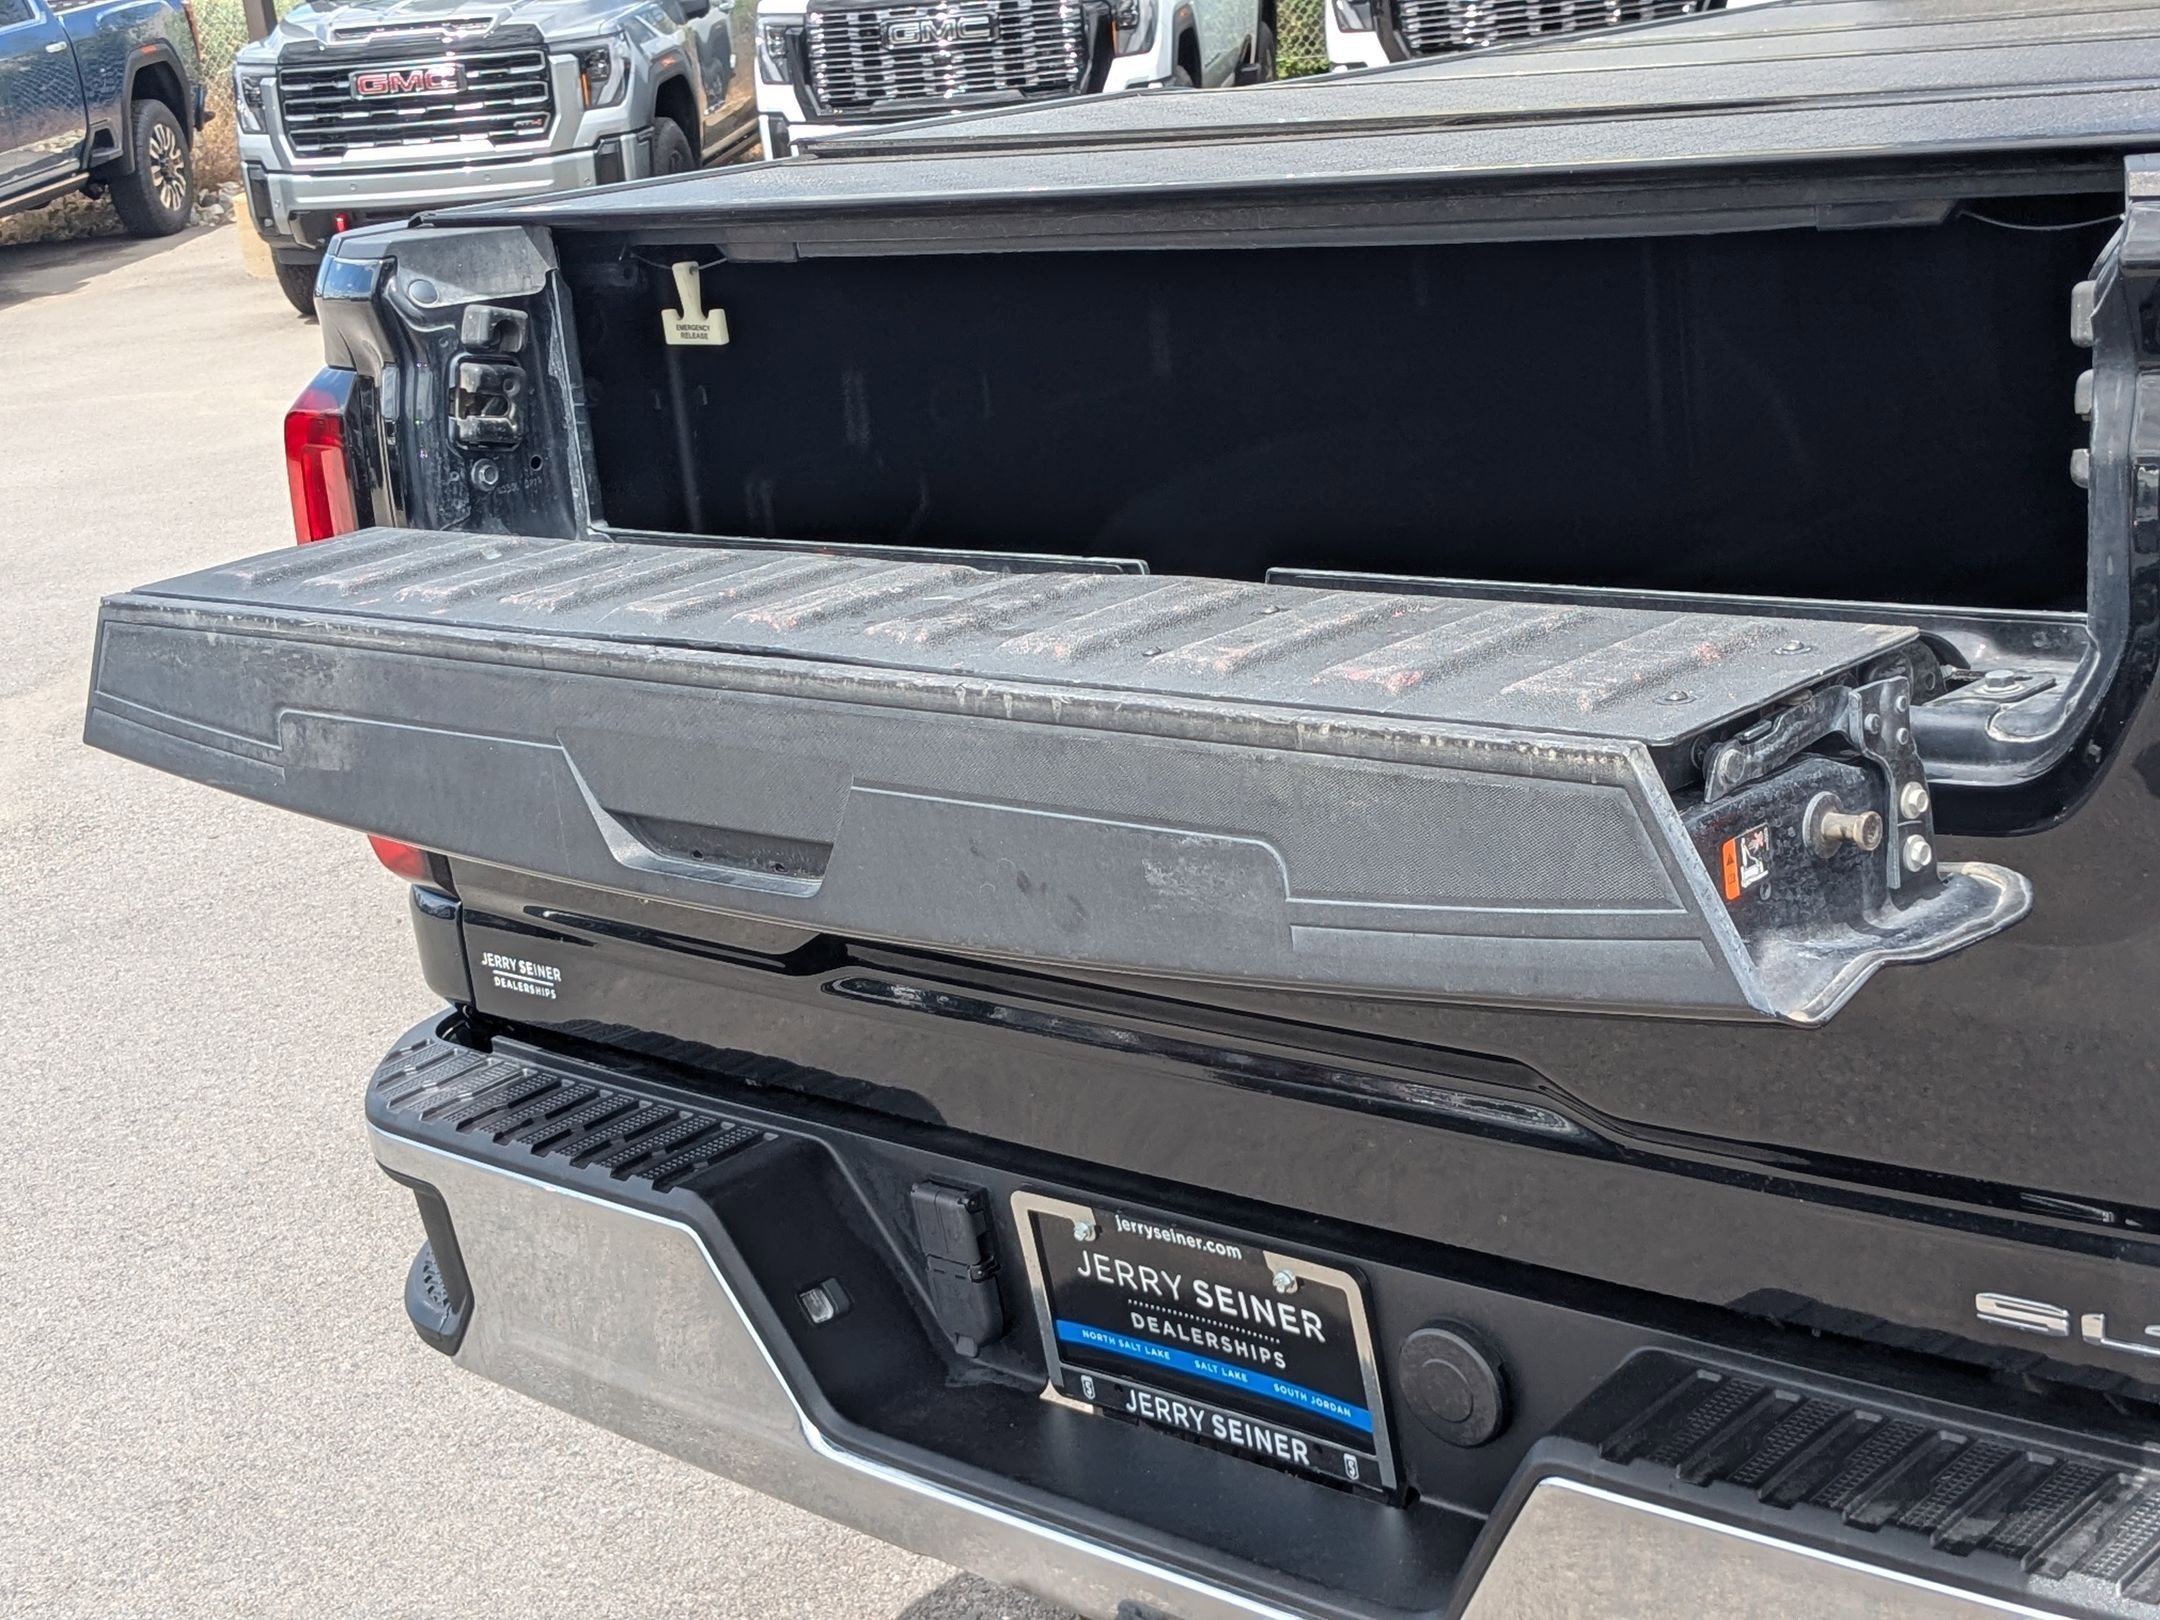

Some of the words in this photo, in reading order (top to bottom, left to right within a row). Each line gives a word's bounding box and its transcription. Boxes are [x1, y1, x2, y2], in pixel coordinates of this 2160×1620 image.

[888, 16, 991, 44] GMC
[357, 66, 457, 95] GMC
[481, 952, 517, 972] JERRY
[518, 960, 562, 982] SEINER
[493, 976, 557, 999] DEALERSHIPS
[1115, 1214, 1243, 1260] jerryseiner.com
[1077, 1250, 1182, 1300] JERRY
[1192, 1279, 1326, 1343] SEINER
[1130, 1312, 1287, 1369] DEALERSHIPS
[1975, 1292, 2160, 1358] SL
[1082, 1330, 1117, 1346] NORTH
[1118, 1339, 1143, 1352] SALT
[1144, 1346, 1171, 1361] LAKE
[1194, 1360, 1219, 1374] SALT
[1221, 1367, 1249, 1383] LAKE
[1273, 1383, 1308, 1402] SOUTH
[1310, 1396, 1352, 1418] JORDAN
[1126, 1390, 1204, 1434] JERRY
[1211, 1414, 1310, 1466] SEINER
